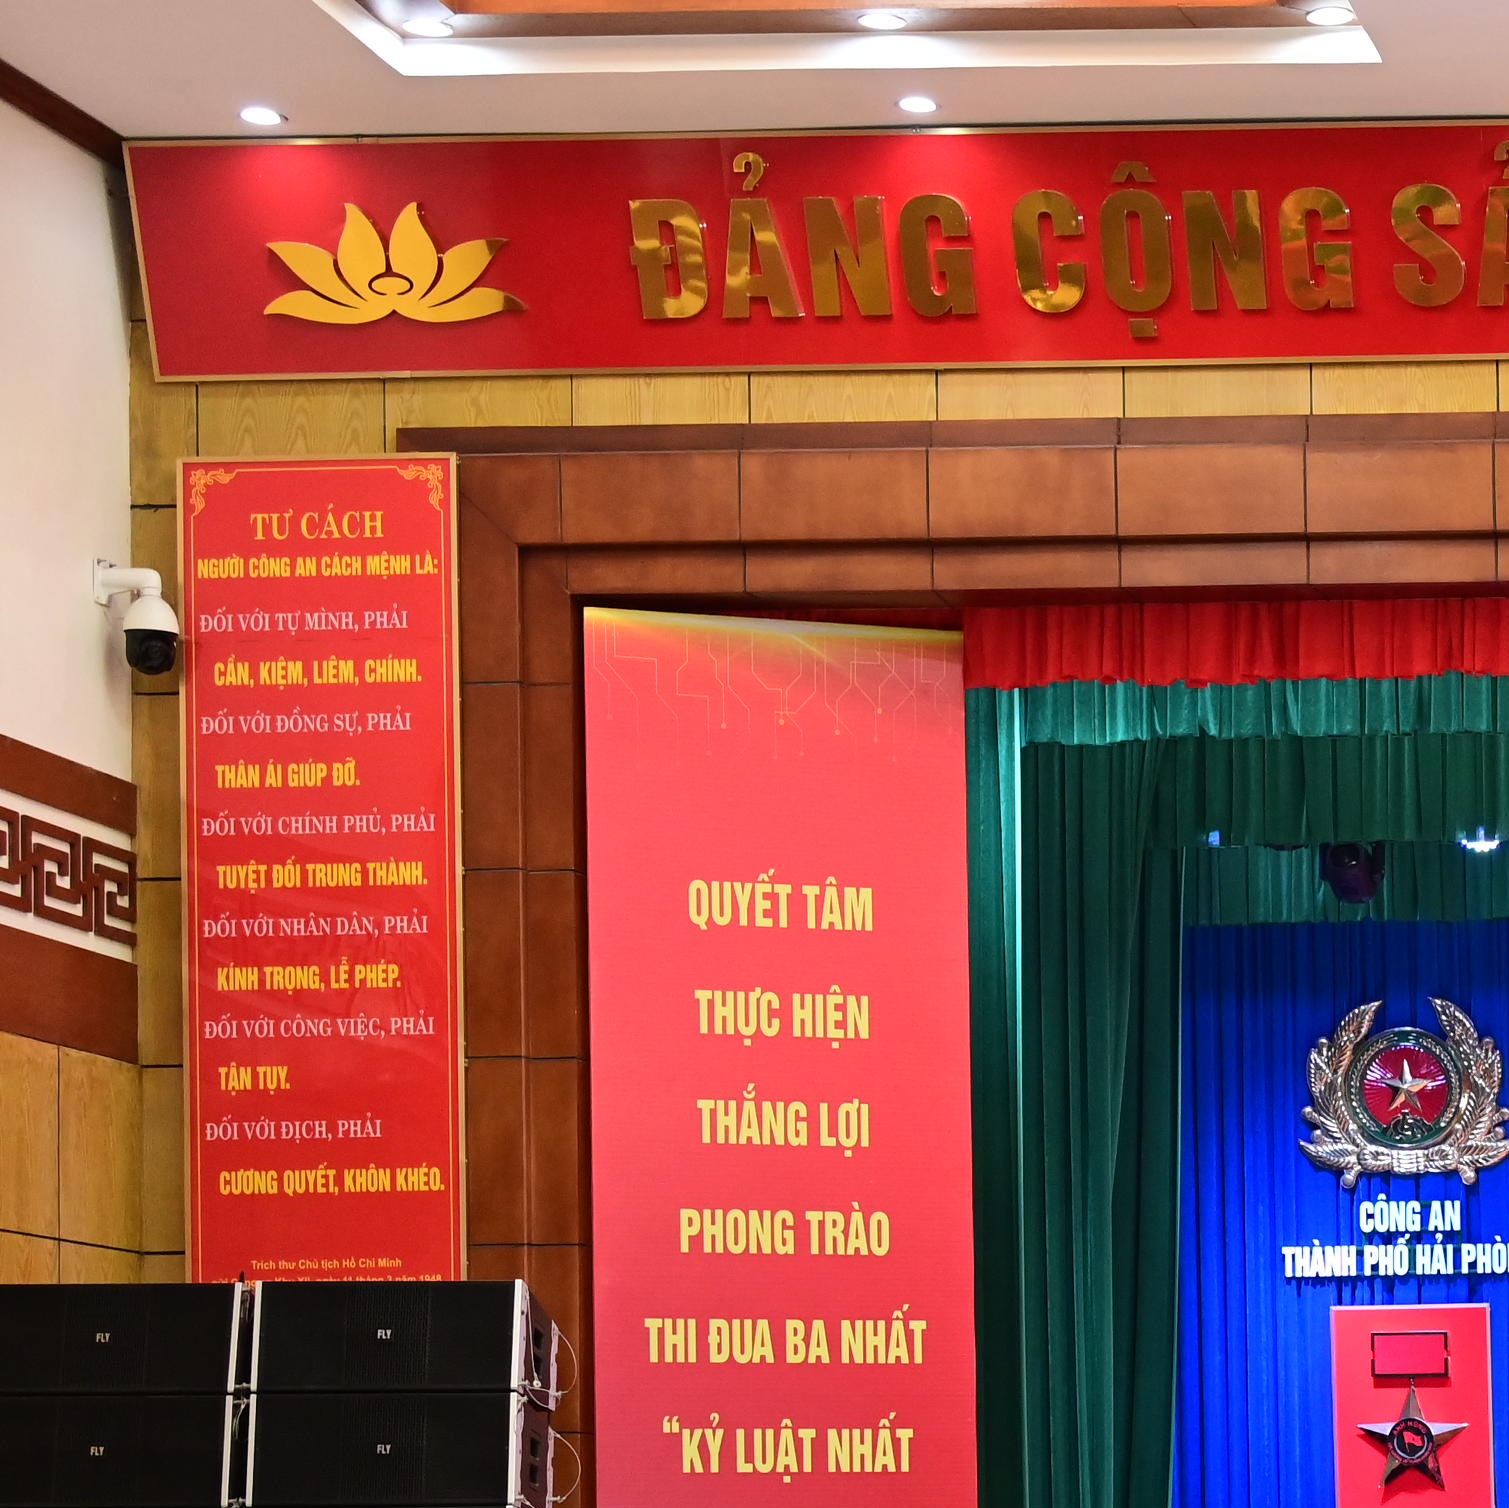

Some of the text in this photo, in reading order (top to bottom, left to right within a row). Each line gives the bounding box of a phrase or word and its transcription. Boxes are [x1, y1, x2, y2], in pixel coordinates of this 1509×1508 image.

[628, 151, 978, 320] ĐẢNG
[1010, 160, 1355, 339] CỘNG
[250, 503, 385, 540] TƯ CÁCH
[197, 549, 439, 580] NGƯỜI CÔNG AN CÁCH MỆNH LÀ:
[214, 654, 423, 690] CẦN, KIỆM, LIÊM, CHÍNH.
[214, 756, 361, 789] THÂN ÁI GIÚP ĐỠ.
[688, 868, 873, 932] QUYẾT TÂM
[694, 985, 870, 1049] THỰC HIỆN
[218, 1061, 291, 1096] TẬN TỤY.
[696, 1085, 870, 1158] THẮNG LỢI
[219, 1161, 445, 1197] CƯƠNG QUYẾT, KHÔN KHÉO.
[679, 1201, 890, 1257] PHONG TRÀO
[1359, 1193, 1461, 1233] CÔNG AN
[1281, 1238, 1357, 1278] THÀNH
[1363, 1233, 1411, 1277] PHỐ
[1415, 1232, 1454, 1275] HẢI
[96, 1333, 110, 1342] FLY
[378, 1329, 391, 1339] FLY
[644, 1303, 927, 1364] THI ĐUA BA NHẤT
